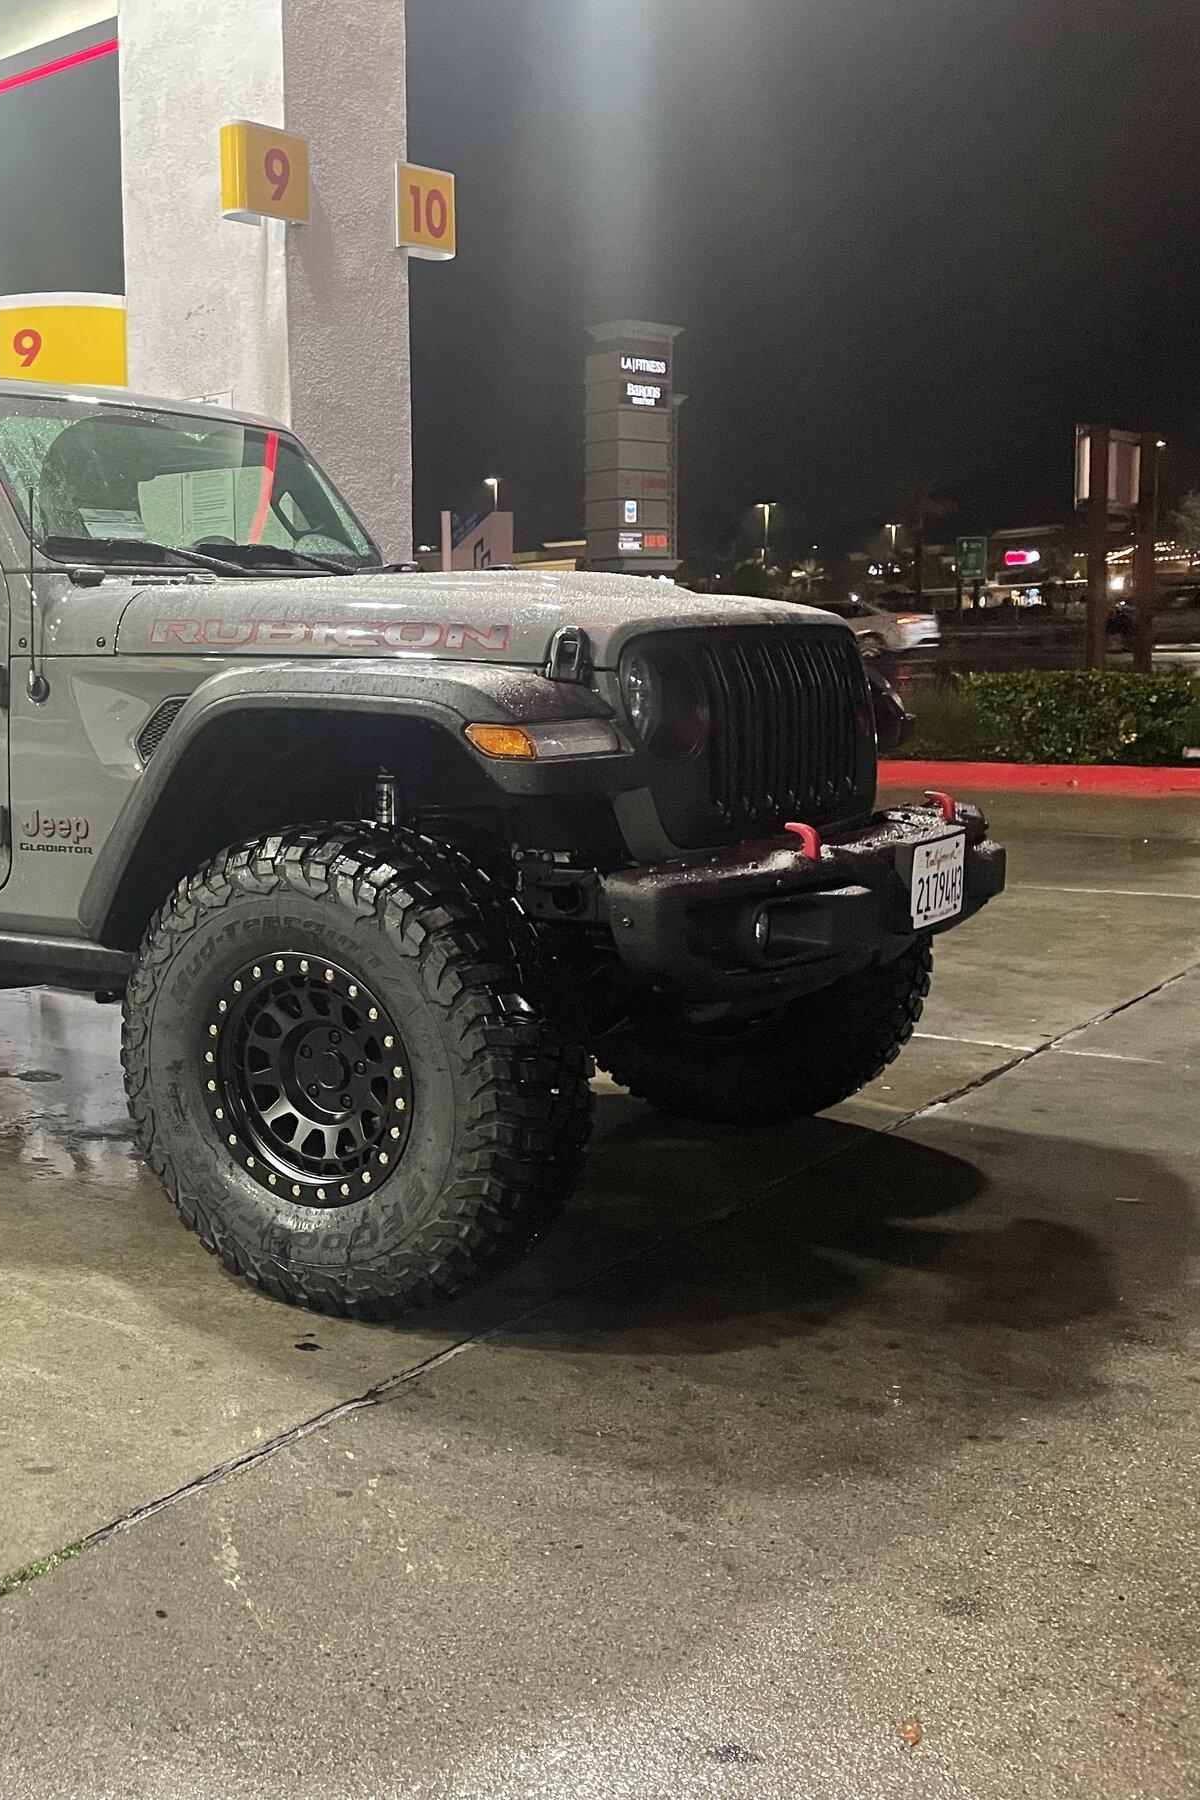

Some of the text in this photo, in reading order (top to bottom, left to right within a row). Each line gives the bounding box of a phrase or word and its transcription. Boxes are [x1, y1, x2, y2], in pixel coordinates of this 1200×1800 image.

[264, 148, 290, 201] 9
[409, 185, 447, 238] 10
[13, 329, 42, 367] 9
[620, 356, 667, 374] LA FITNESS
[150, 618, 511, 651] RUBICON
[22, 809, 90, 845] Jeep
[19, 842, 94, 855] GLADIATOR
[916, 864, 962, 915] 21794H3
